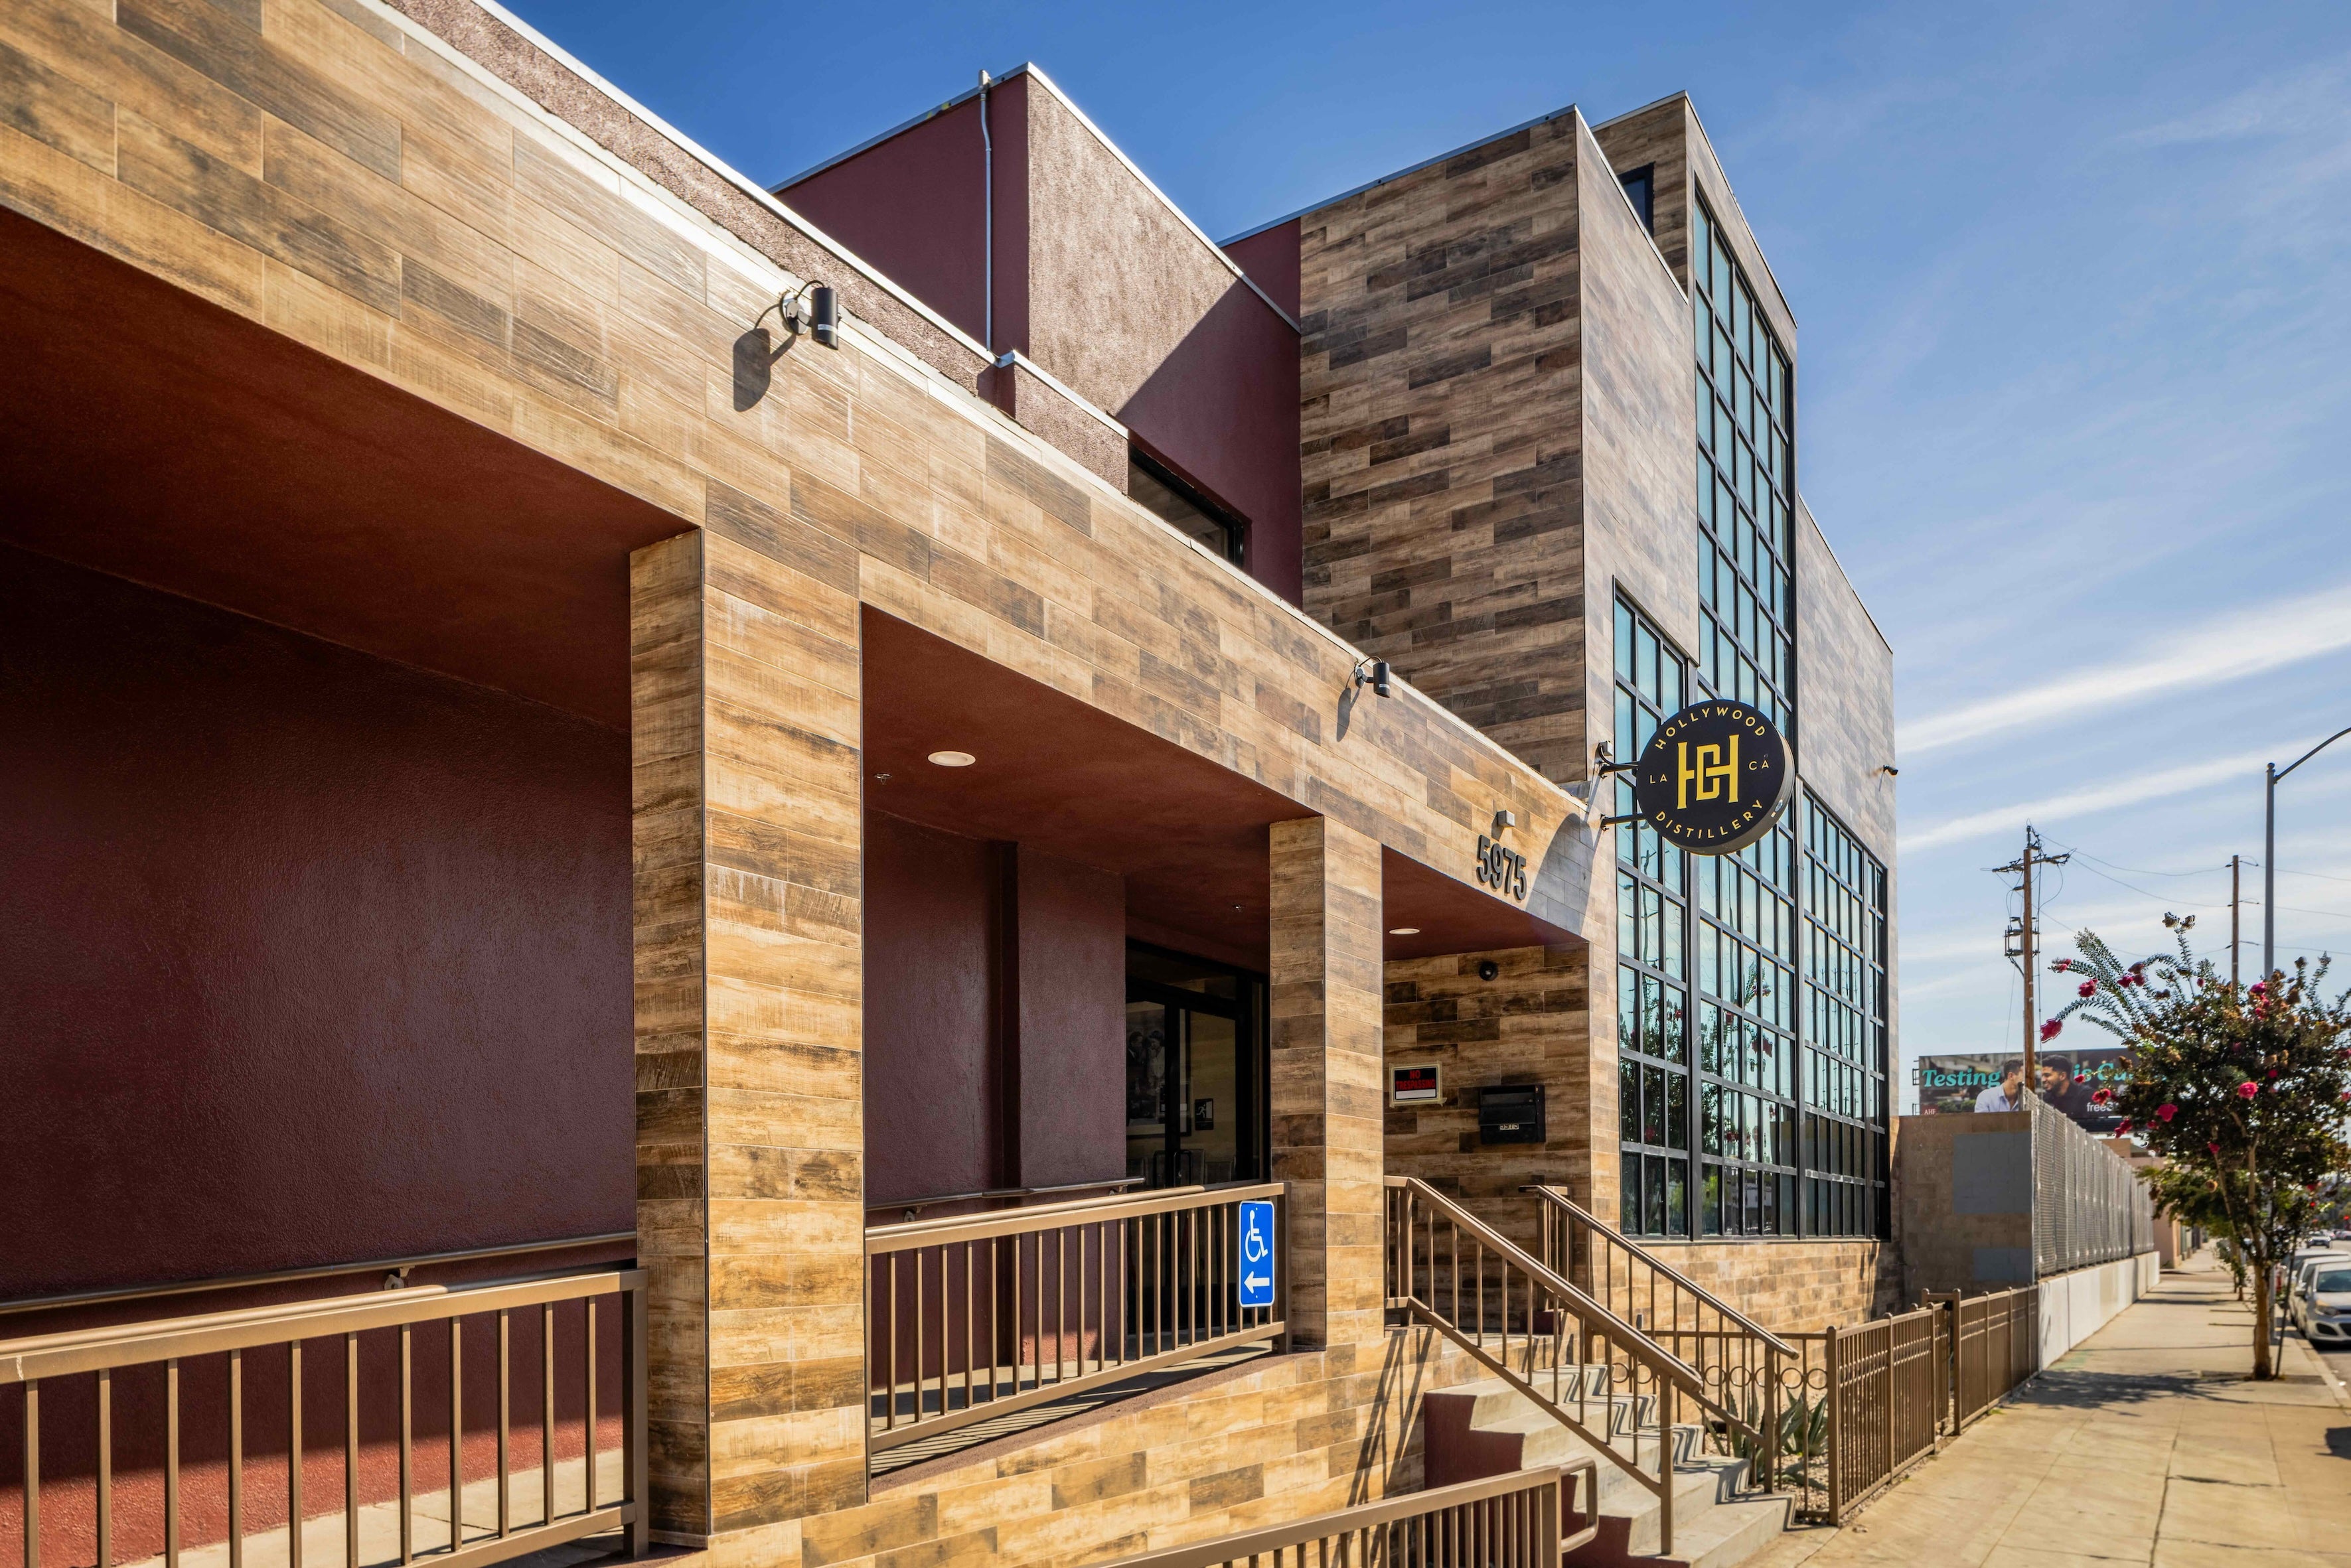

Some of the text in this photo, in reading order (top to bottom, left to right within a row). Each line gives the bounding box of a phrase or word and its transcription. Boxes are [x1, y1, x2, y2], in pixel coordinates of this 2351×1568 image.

[1655, 706, 1766, 750] HOLLYWOOD
[1748, 760, 1770, 770] CA
[1649, 773, 1667, 784] LA
[1655, 800, 1763, 839] DISTILLERY
[1476, 834, 1527, 901] 5975
[1409, 1070, 1421, 1080] NO
[1922, 1068, 2001, 1089] Testing
[1396, 1079, 1436, 1090] TRESPASSING
